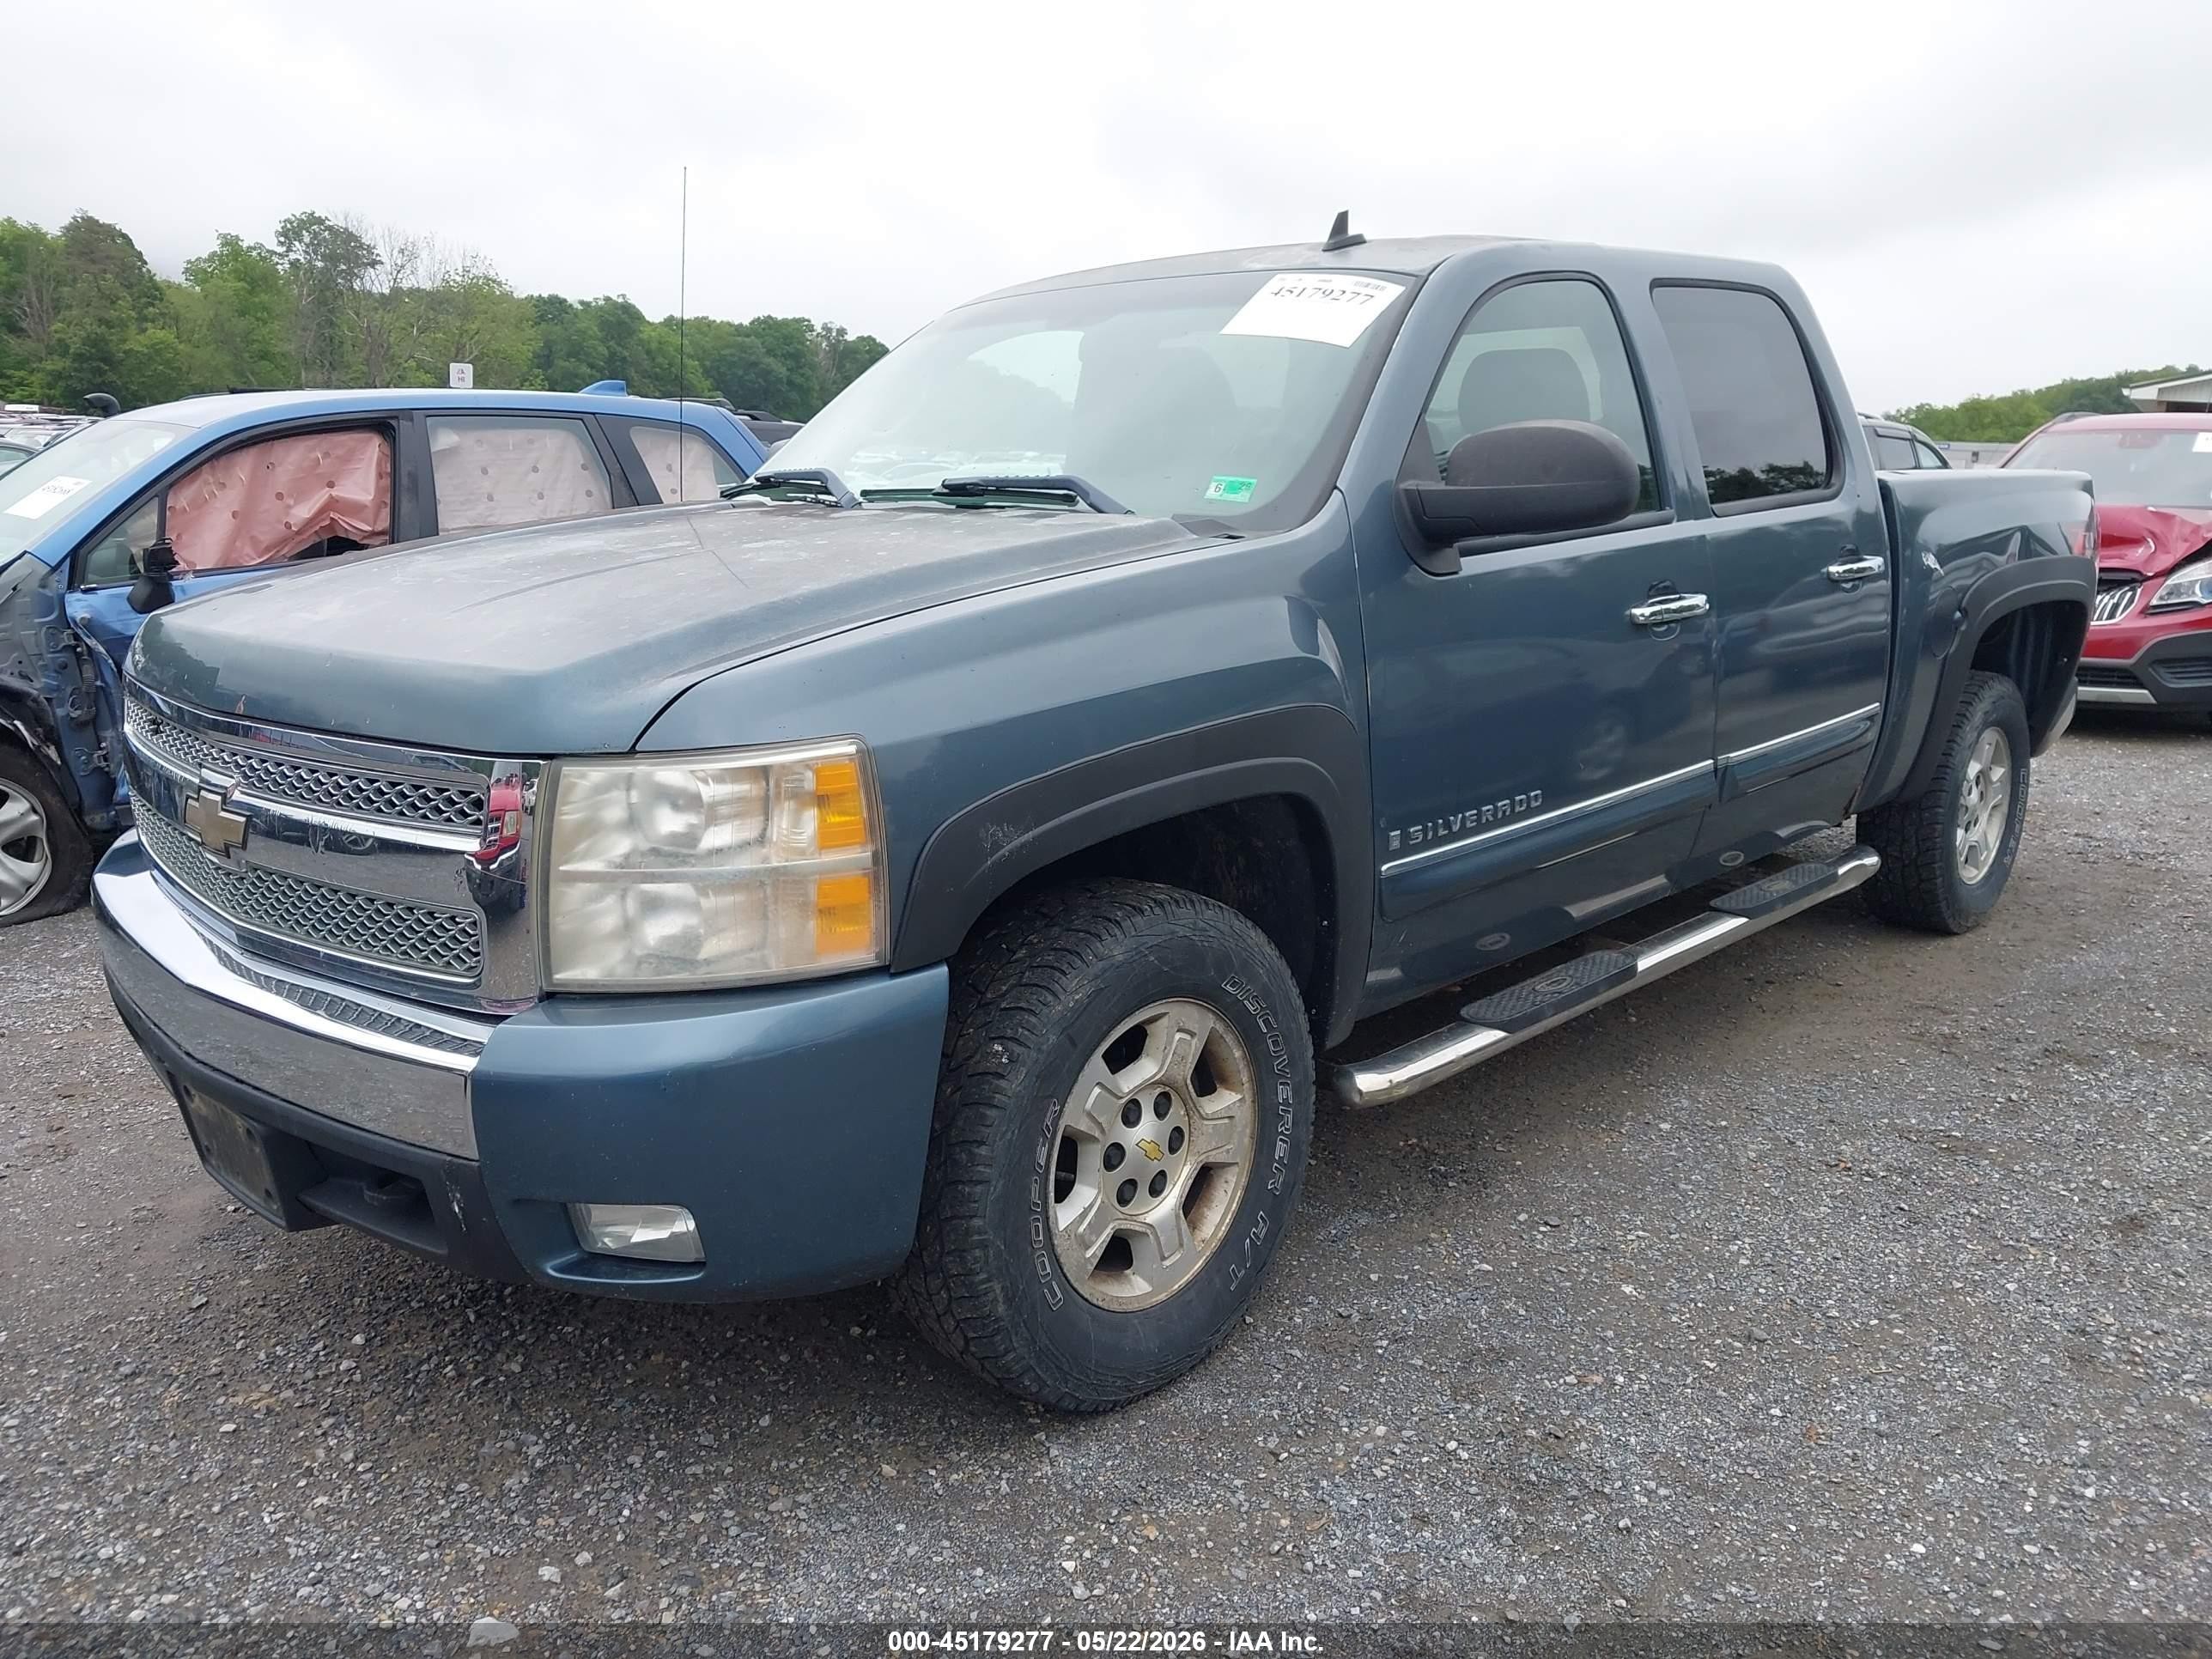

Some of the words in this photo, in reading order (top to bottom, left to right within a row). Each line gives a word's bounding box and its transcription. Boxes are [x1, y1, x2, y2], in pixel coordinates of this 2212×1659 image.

[1270, 286, 1375, 306] 45179277
[1408, 789, 1543, 846] SILVERADO
[1221, 974, 1293, 1195] DISCOVERER
[1030, 1098, 1064, 1311] COOPER
[1230, 1210, 1270, 1291] A/T
